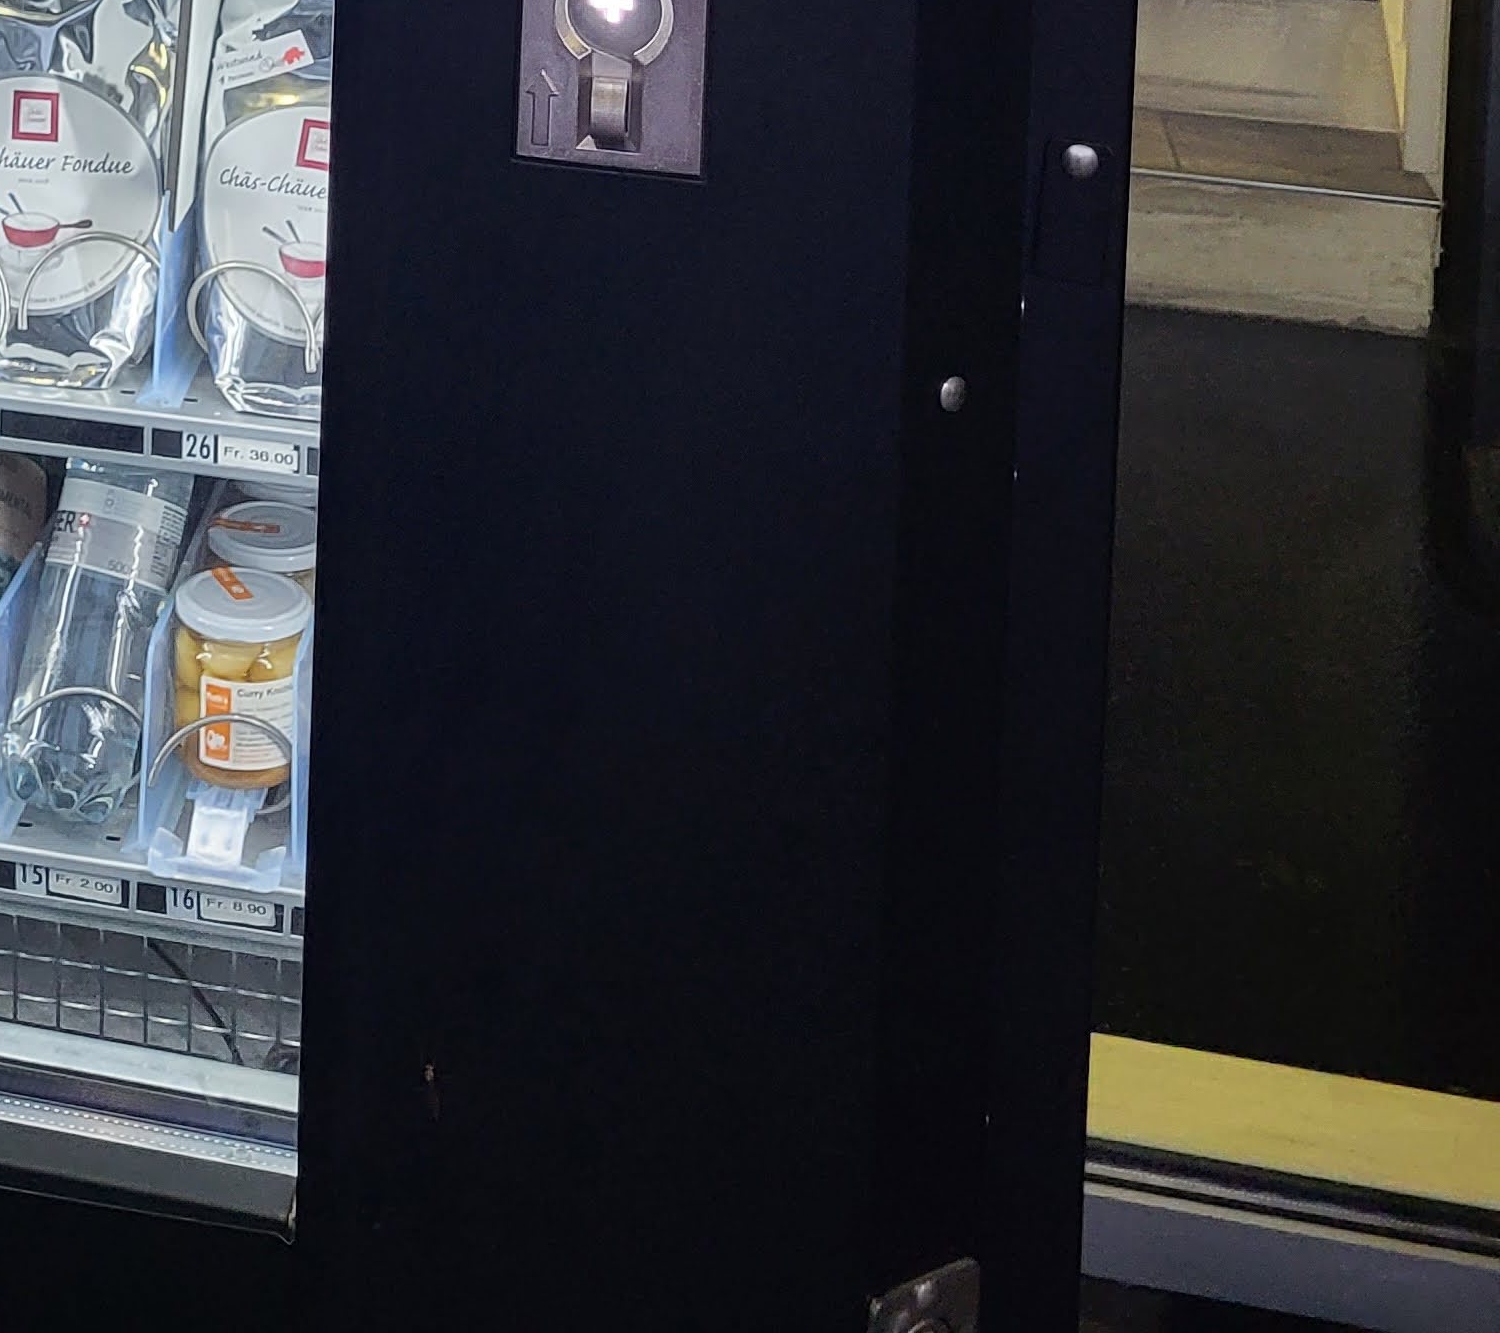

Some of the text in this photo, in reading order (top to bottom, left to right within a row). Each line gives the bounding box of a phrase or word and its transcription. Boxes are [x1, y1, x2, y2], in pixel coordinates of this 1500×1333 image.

[62, 153, 133, 174] Fondue
[186, 434, 210, 459] 26
[237, 687, 264, 699] Curry
[20, 863, 43, 885] 15
[172, 888, 194, 909] 16
